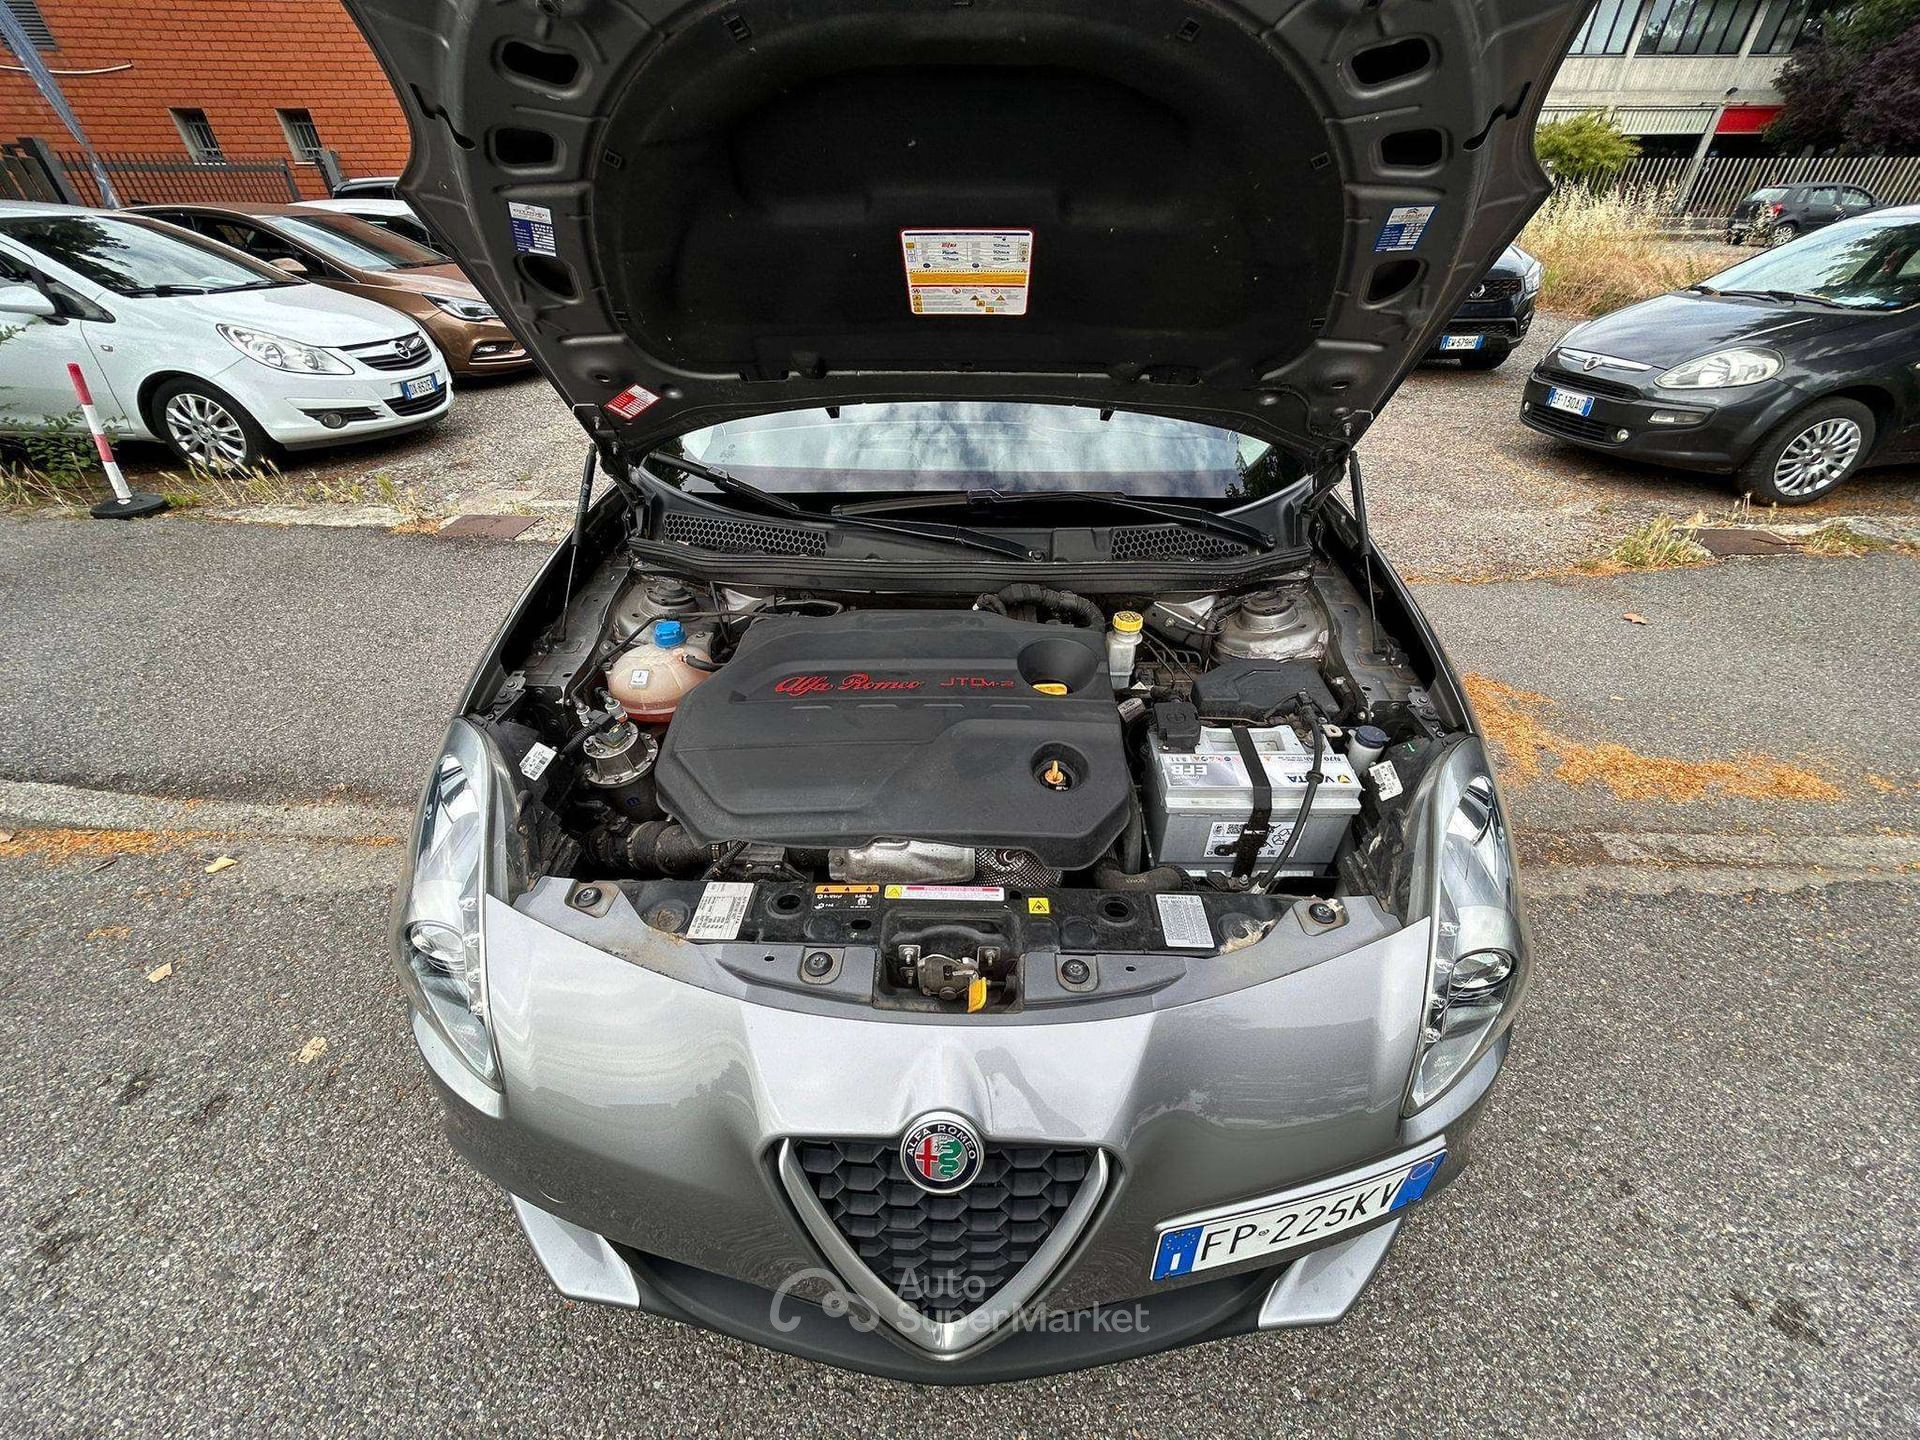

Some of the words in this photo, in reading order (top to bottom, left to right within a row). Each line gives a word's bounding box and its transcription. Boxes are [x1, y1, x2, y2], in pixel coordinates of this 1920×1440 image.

[774, 674, 834, 697] Alfa
[837, 672, 924, 690] Romeo
[1170, 764, 1208, 775] EFB
[1287, 775, 1336, 783] VTA
[906, 1128, 932, 1157] ALFA
[937, 1124, 977, 1160] ROMEO
[1200, 1224, 1258, 1261] FP
[1269, 1178, 1404, 1244] 225KV
